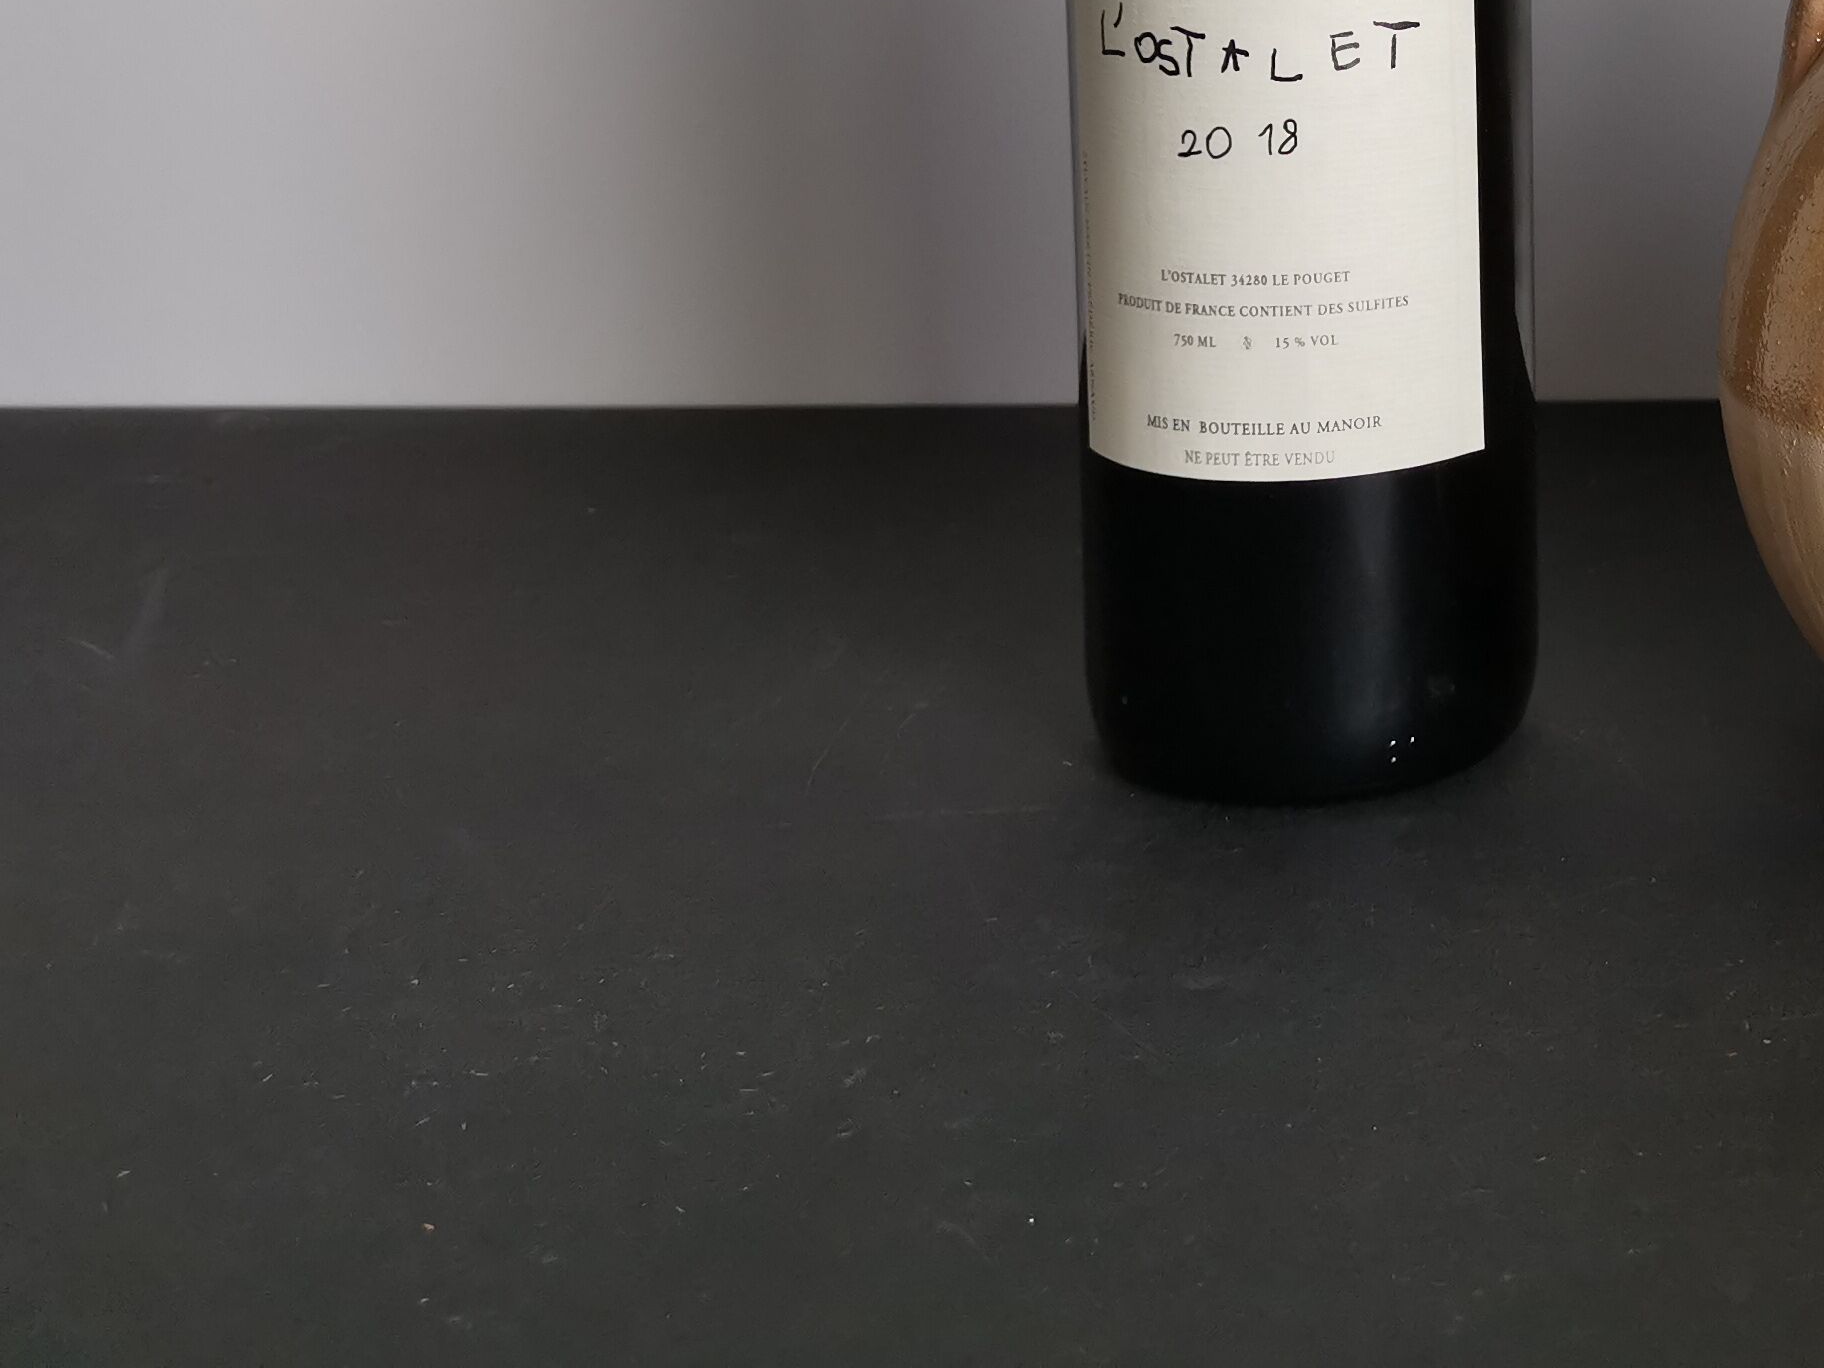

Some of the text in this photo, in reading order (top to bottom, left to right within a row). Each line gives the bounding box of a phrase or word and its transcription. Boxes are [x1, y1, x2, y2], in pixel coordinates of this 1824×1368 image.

[1161, 269, 1350, 287] L'OSTALET 34280 LE POUGET
[1117, 292, 1409, 318] PRODUIT DE FRANCE CONTIENT DES SULFITES
[1173, 333, 1217, 348] 750 ML
[1275, 333, 1339, 349] 15 % VOL
[1146, 414, 1383, 436] MIS EN BOUTEILLE AU MANOIR
[1184, 449, 1336, 467] NE PEUT ÊTRE VENDU
